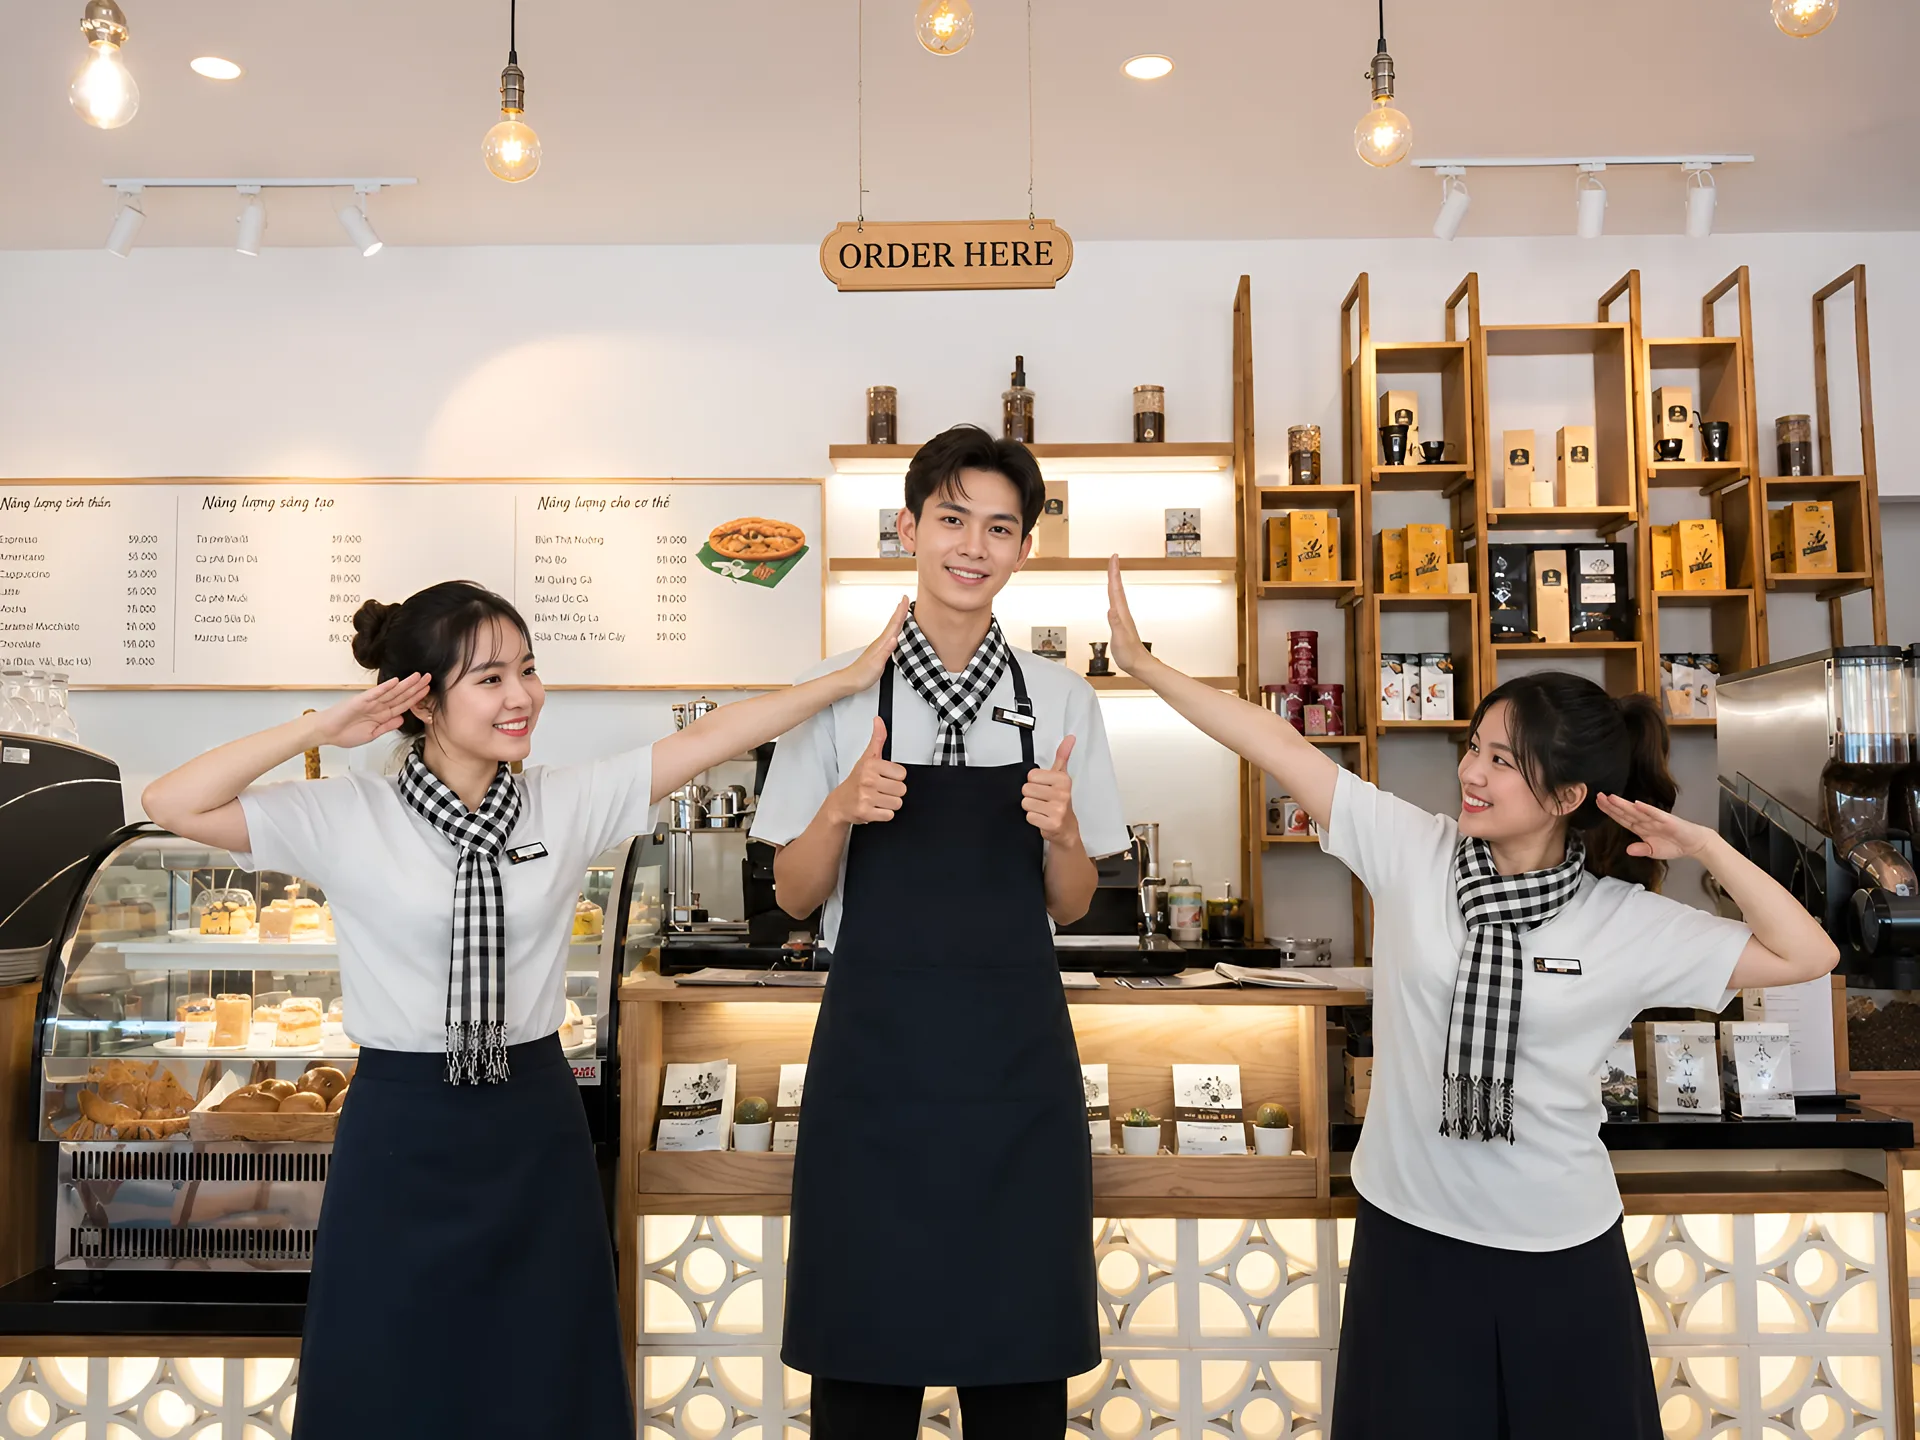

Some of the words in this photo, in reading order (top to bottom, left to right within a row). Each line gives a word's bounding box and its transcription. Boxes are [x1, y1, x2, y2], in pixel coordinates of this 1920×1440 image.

[838, 242, 955, 269] ORDER
[963, 240, 1054, 267] HERE
[537, 496, 571, 513] Năng
[610, 495, 631, 508] cho
